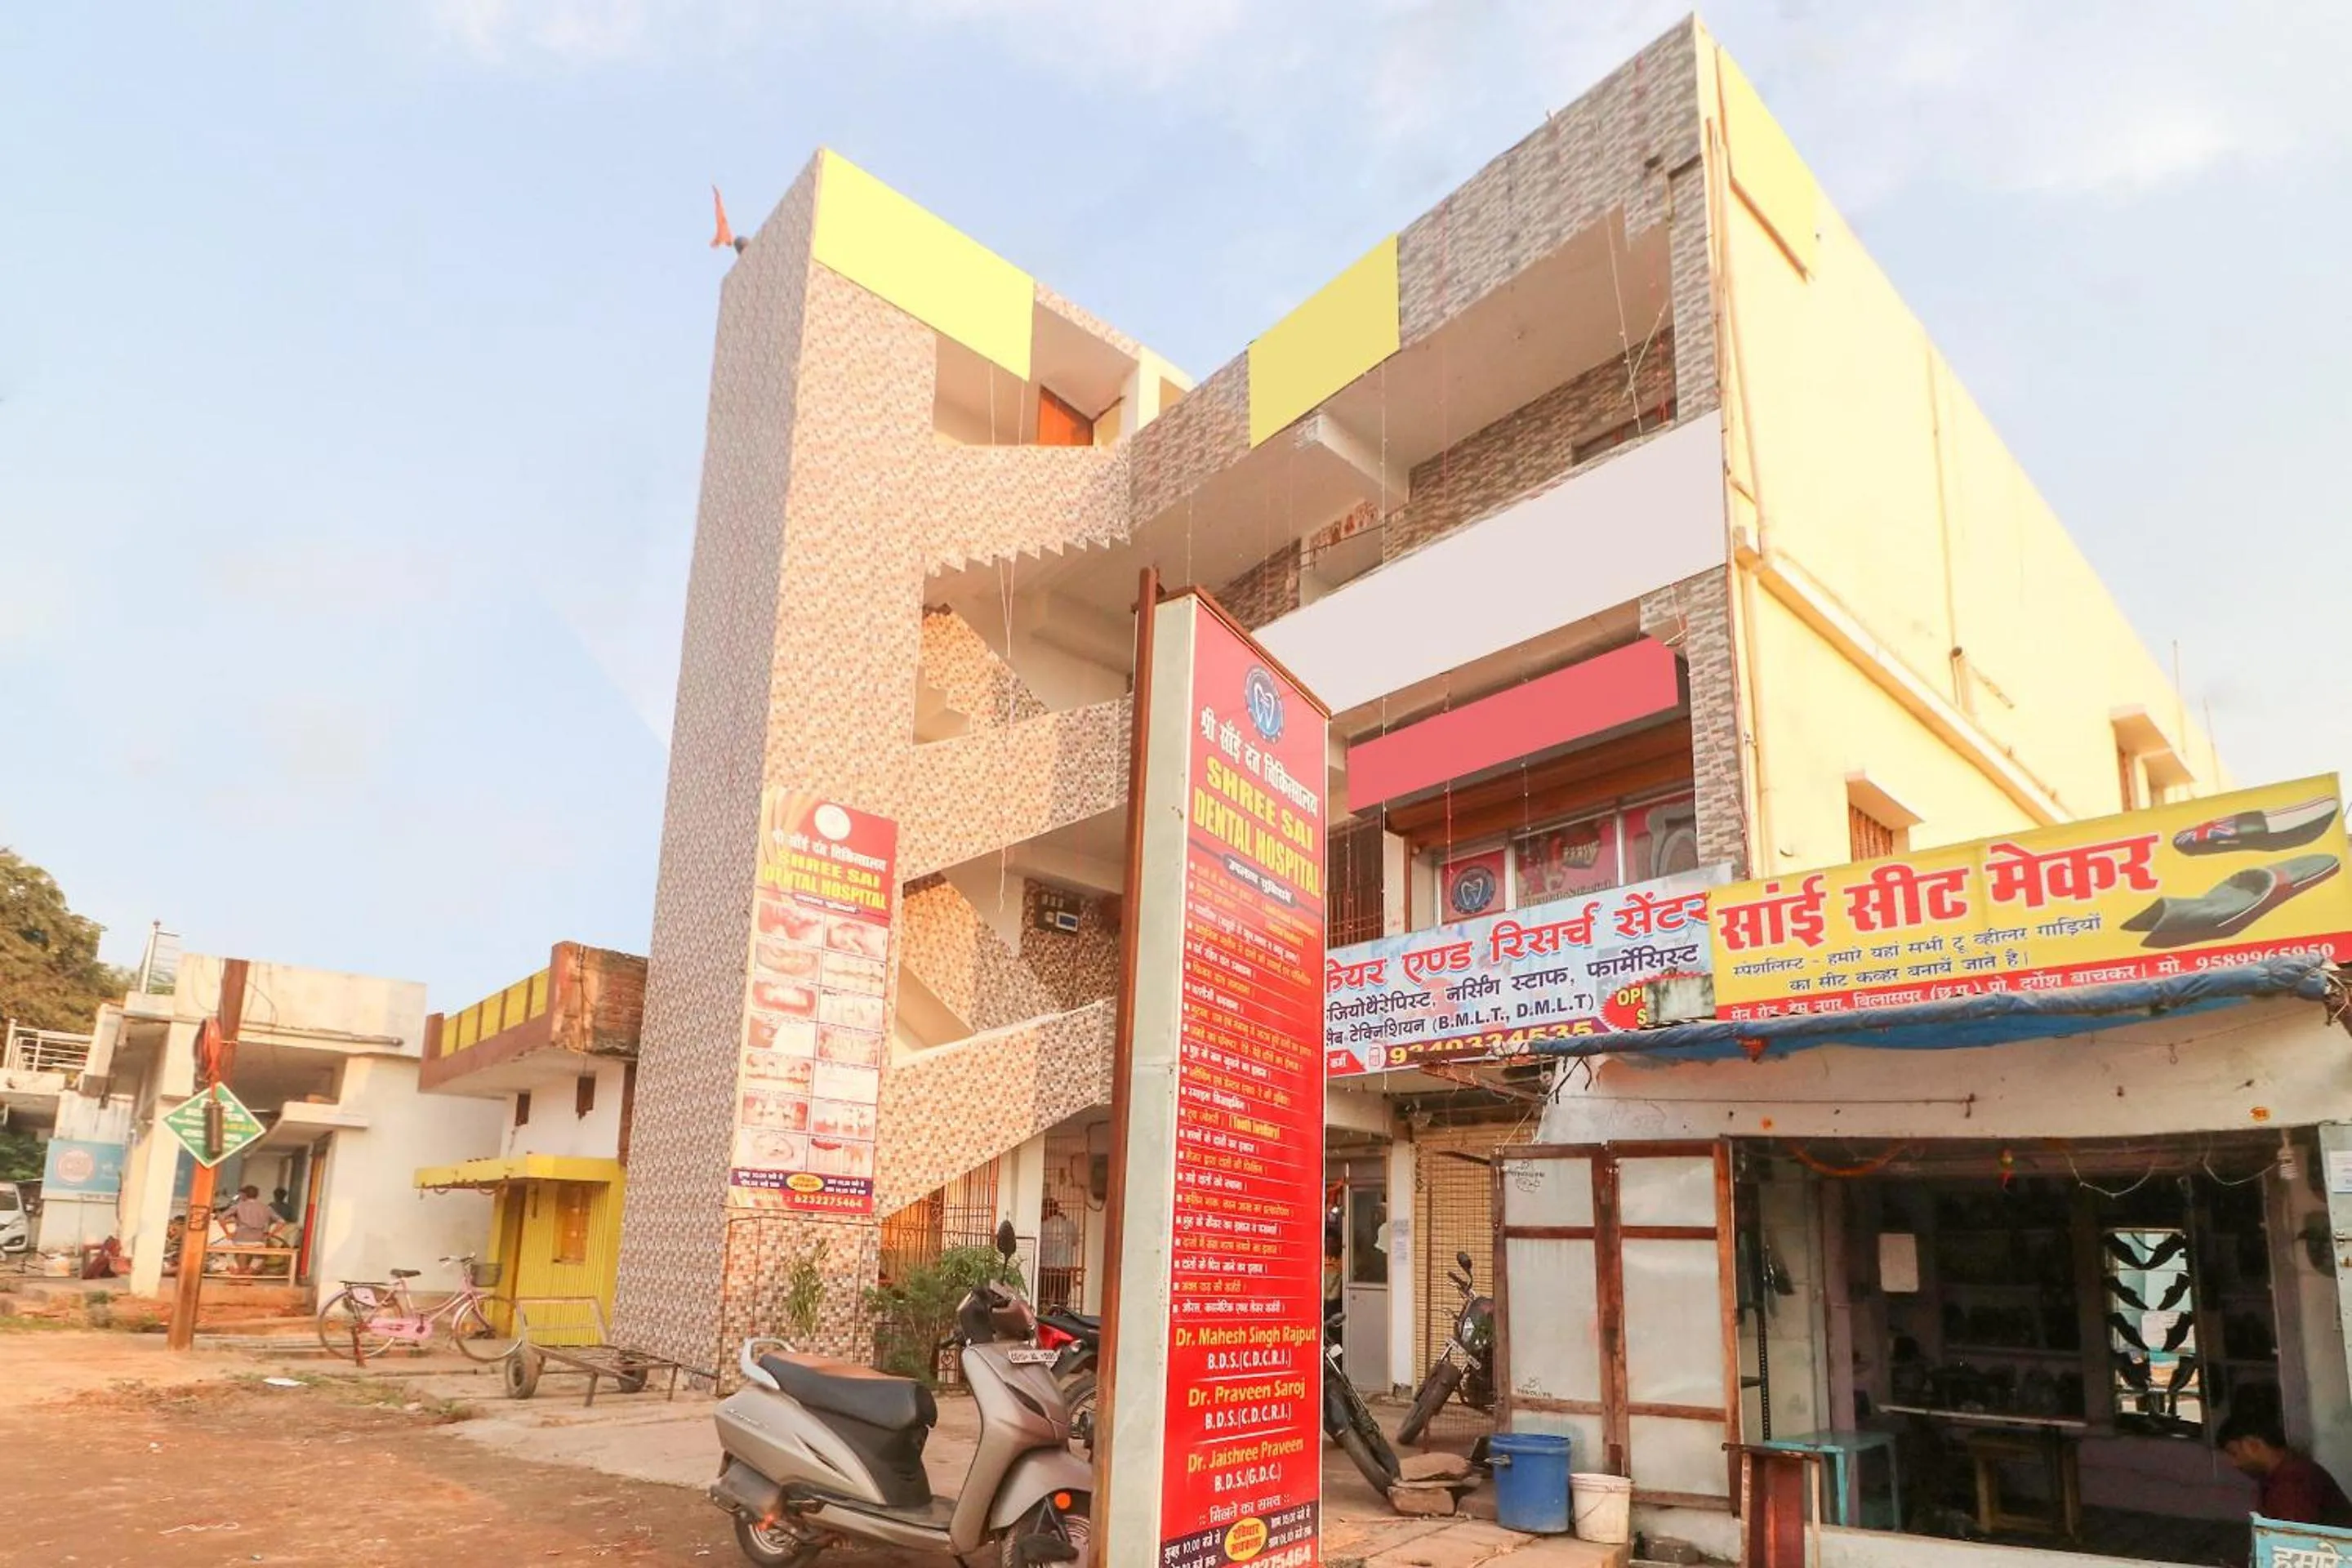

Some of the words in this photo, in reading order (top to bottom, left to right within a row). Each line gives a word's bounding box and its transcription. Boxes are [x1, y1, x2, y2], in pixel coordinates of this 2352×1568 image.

[1206, 754, 1276, 827] SHREE
[1281, 808, 1313, 852] SAI
[1193, 786, 1252, 857] DENTAL
[1255, 827, 1321, 899] HOSPITAL
[764, 864, 817, 893] DENTAL
[821, 878, 887, 910] HOSPITAL
[777, 850, 842, 879] SHREE
[847, 868, 880, 888] SAI
[1844, 864, 1969, 932] सीट
[1985, 835, 2159, 908] मेकर
[1401, 941, 1472, 983] एण्ड
[1490, 902, 1600, 964] रिसर्च
[1614, 891, 1710, 937] सेंटर
[1908, 935, 1944, 954] सभी
[1819, 972, 1848, 987] सीट
[1962, 952, 1996, 970] जाते
[1616, 986, 1646, 1006] OP
[1175, 1328, 1196, 1346] Dr.
[1199, 1327, 1245, 1346] Mahesh
[1249, 1326, 1281, 1348] Singh
[1282, 1325, 1316, 1348] Rajput
[1187, 1388, 1211, 1407] Dr.
[1215, 1383, 1271, 1404] Praveen
[1274, 1378, 1306, 1399] Saroj
[1187, 1454, 1206, 1473] Dr.
[1209, 1446, 1258, 1468] Jaishree
[1260, 1438, 1303, 1459] Praveen
